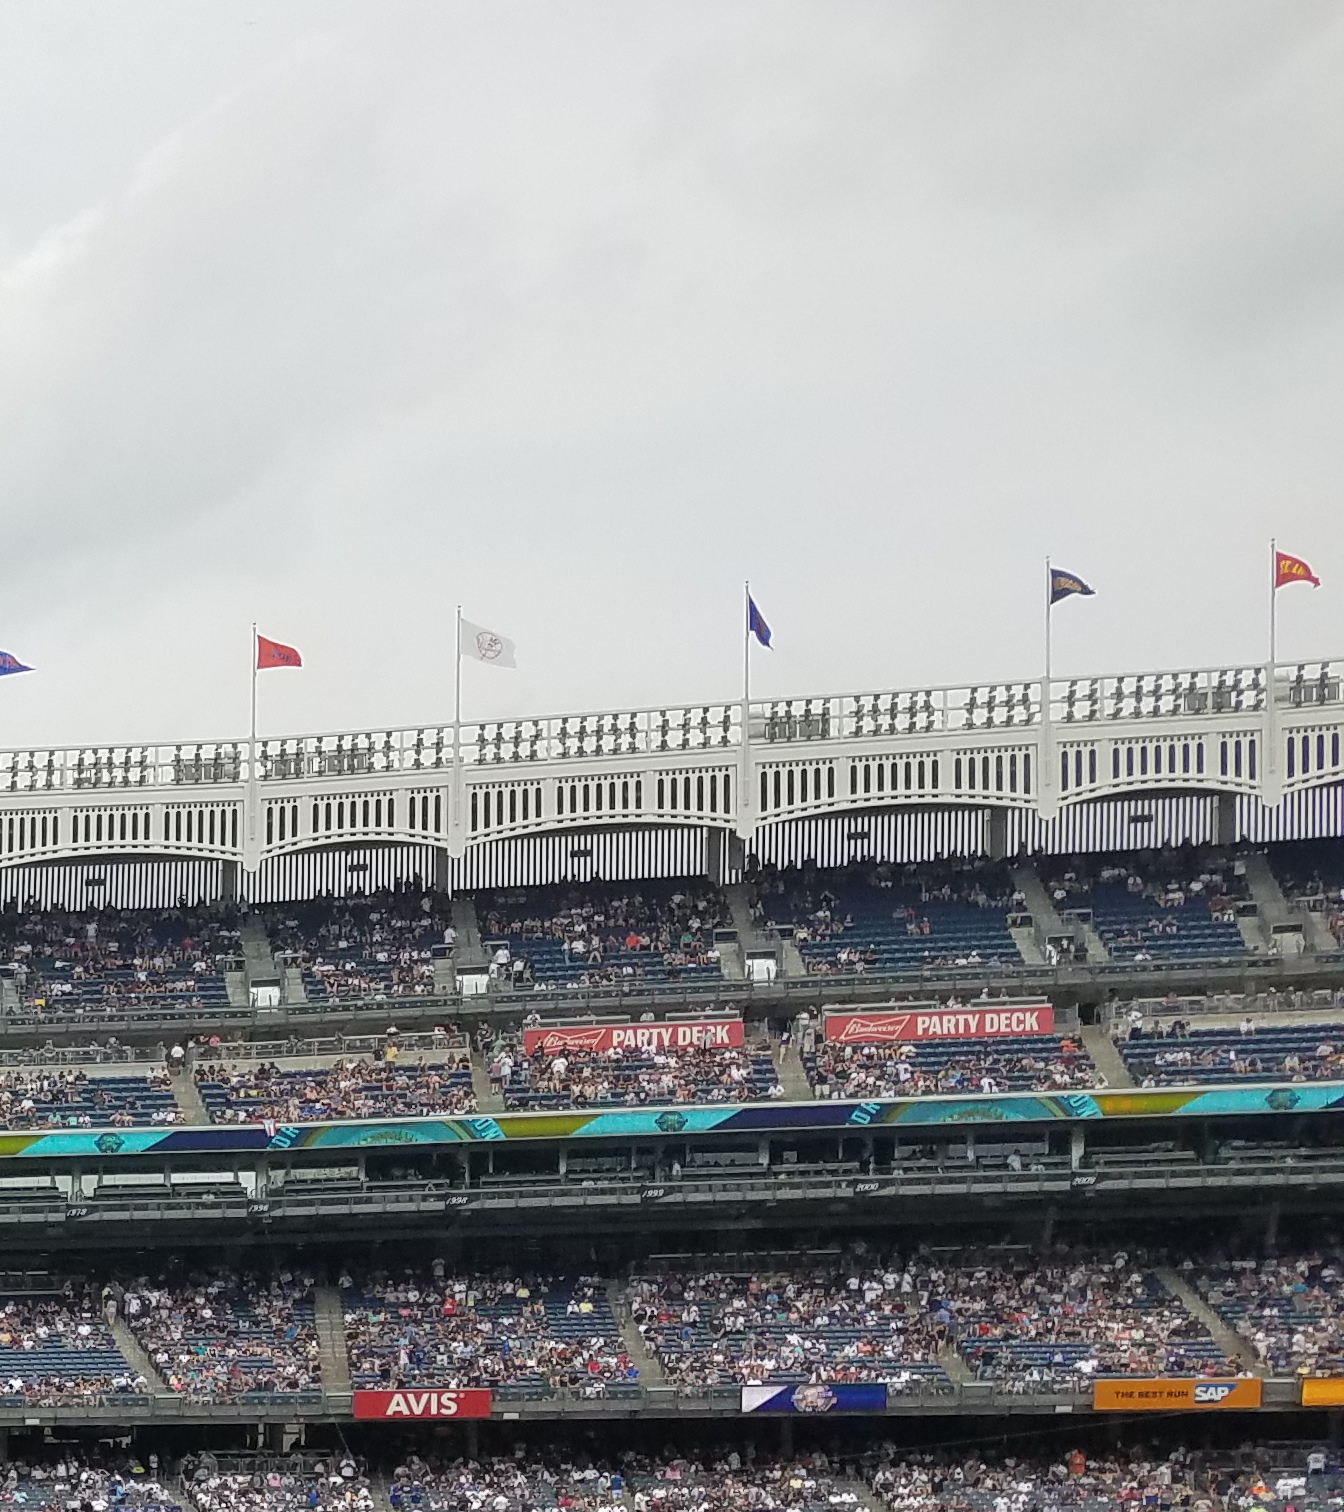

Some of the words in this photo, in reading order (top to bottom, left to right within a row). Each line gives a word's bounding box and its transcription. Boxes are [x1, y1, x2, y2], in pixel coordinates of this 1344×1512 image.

[917, 1013, 980, 1036] PARTY
[985, 1011, 1039, 1033] DECK
[612, 1028, 672, 1049] PARTY
[385, 1392, 458, 1416] AVIS
[1114, 1390, 1135, 1399] THE
[1138, 1390, 1164, 1399] BEST
[1194, 1386, 1230, 1401] SAP
